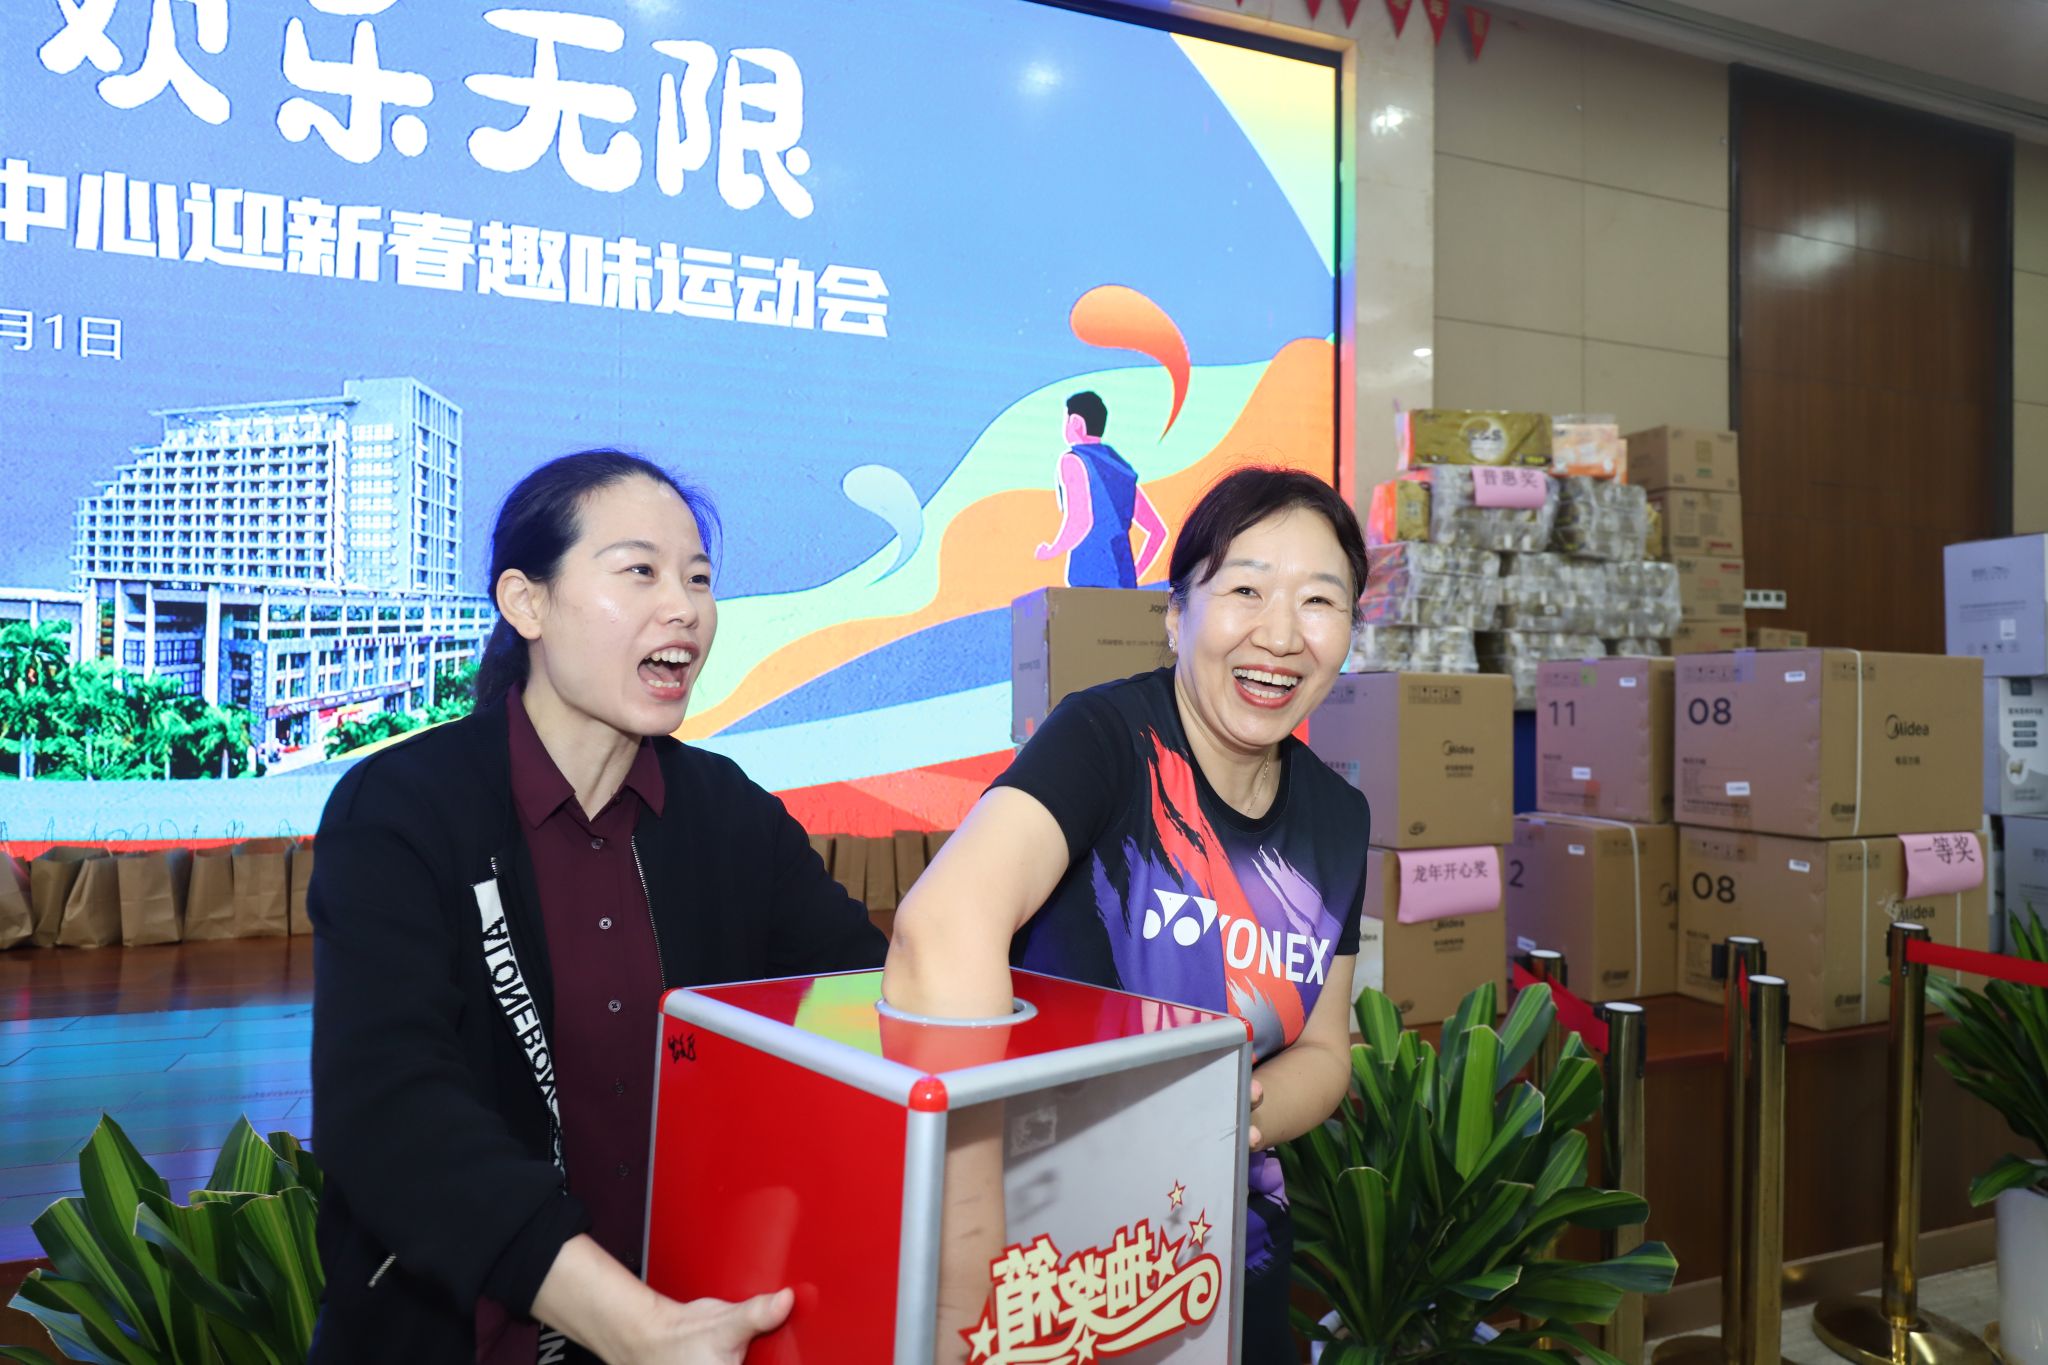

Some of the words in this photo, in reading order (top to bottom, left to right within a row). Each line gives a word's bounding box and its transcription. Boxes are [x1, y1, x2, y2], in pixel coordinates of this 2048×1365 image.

[0, 158, 890, 338] 中心迎新春趣味运动会
[1548, 699, 1576, 727] 11
[1688, 698, 1732, 726] 08
[1886, 714, 1930, 740] Midea
[1442, 740, 1475, 757] Midea
[1913, 834, 1976, 865] 一等奖
[1412, 859, 1489, 885] 龙年开心奖
[1692, 871, 1736, 904] 08
